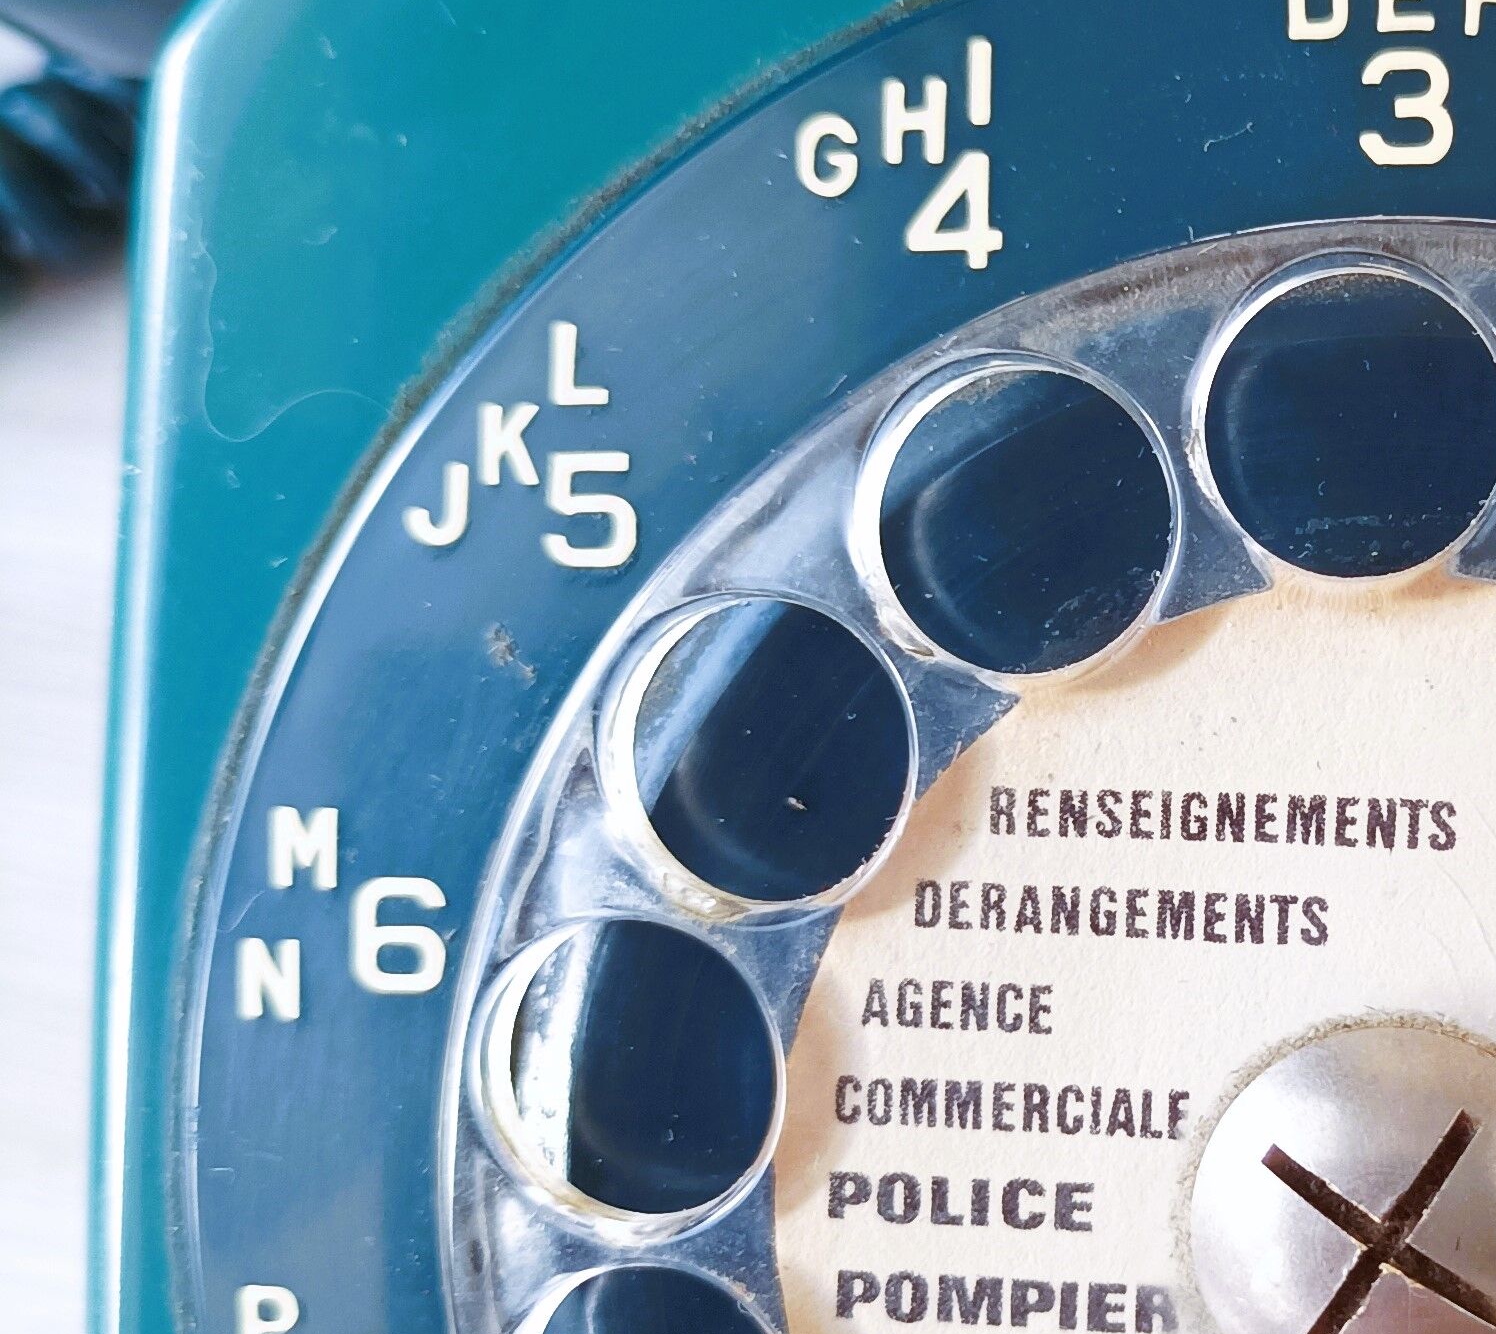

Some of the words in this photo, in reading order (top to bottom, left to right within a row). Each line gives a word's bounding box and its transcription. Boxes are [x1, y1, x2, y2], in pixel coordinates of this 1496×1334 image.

[796, 36, 992, 198] GHI
[1358, 48, 1455, 166] 3
[904, 151, 1003, 269] 4
[542, 451, 637, 569] 5
[989, 786, 1458, 852] RENSEIGNEMENTS
[350, 876, 449, 995] 6
[914, 879, 1331, 947] DERANGEMENTS
[861, 978, 1054, 1035] AGENCE
[827, 1171, 1095, 1232] POLICE
